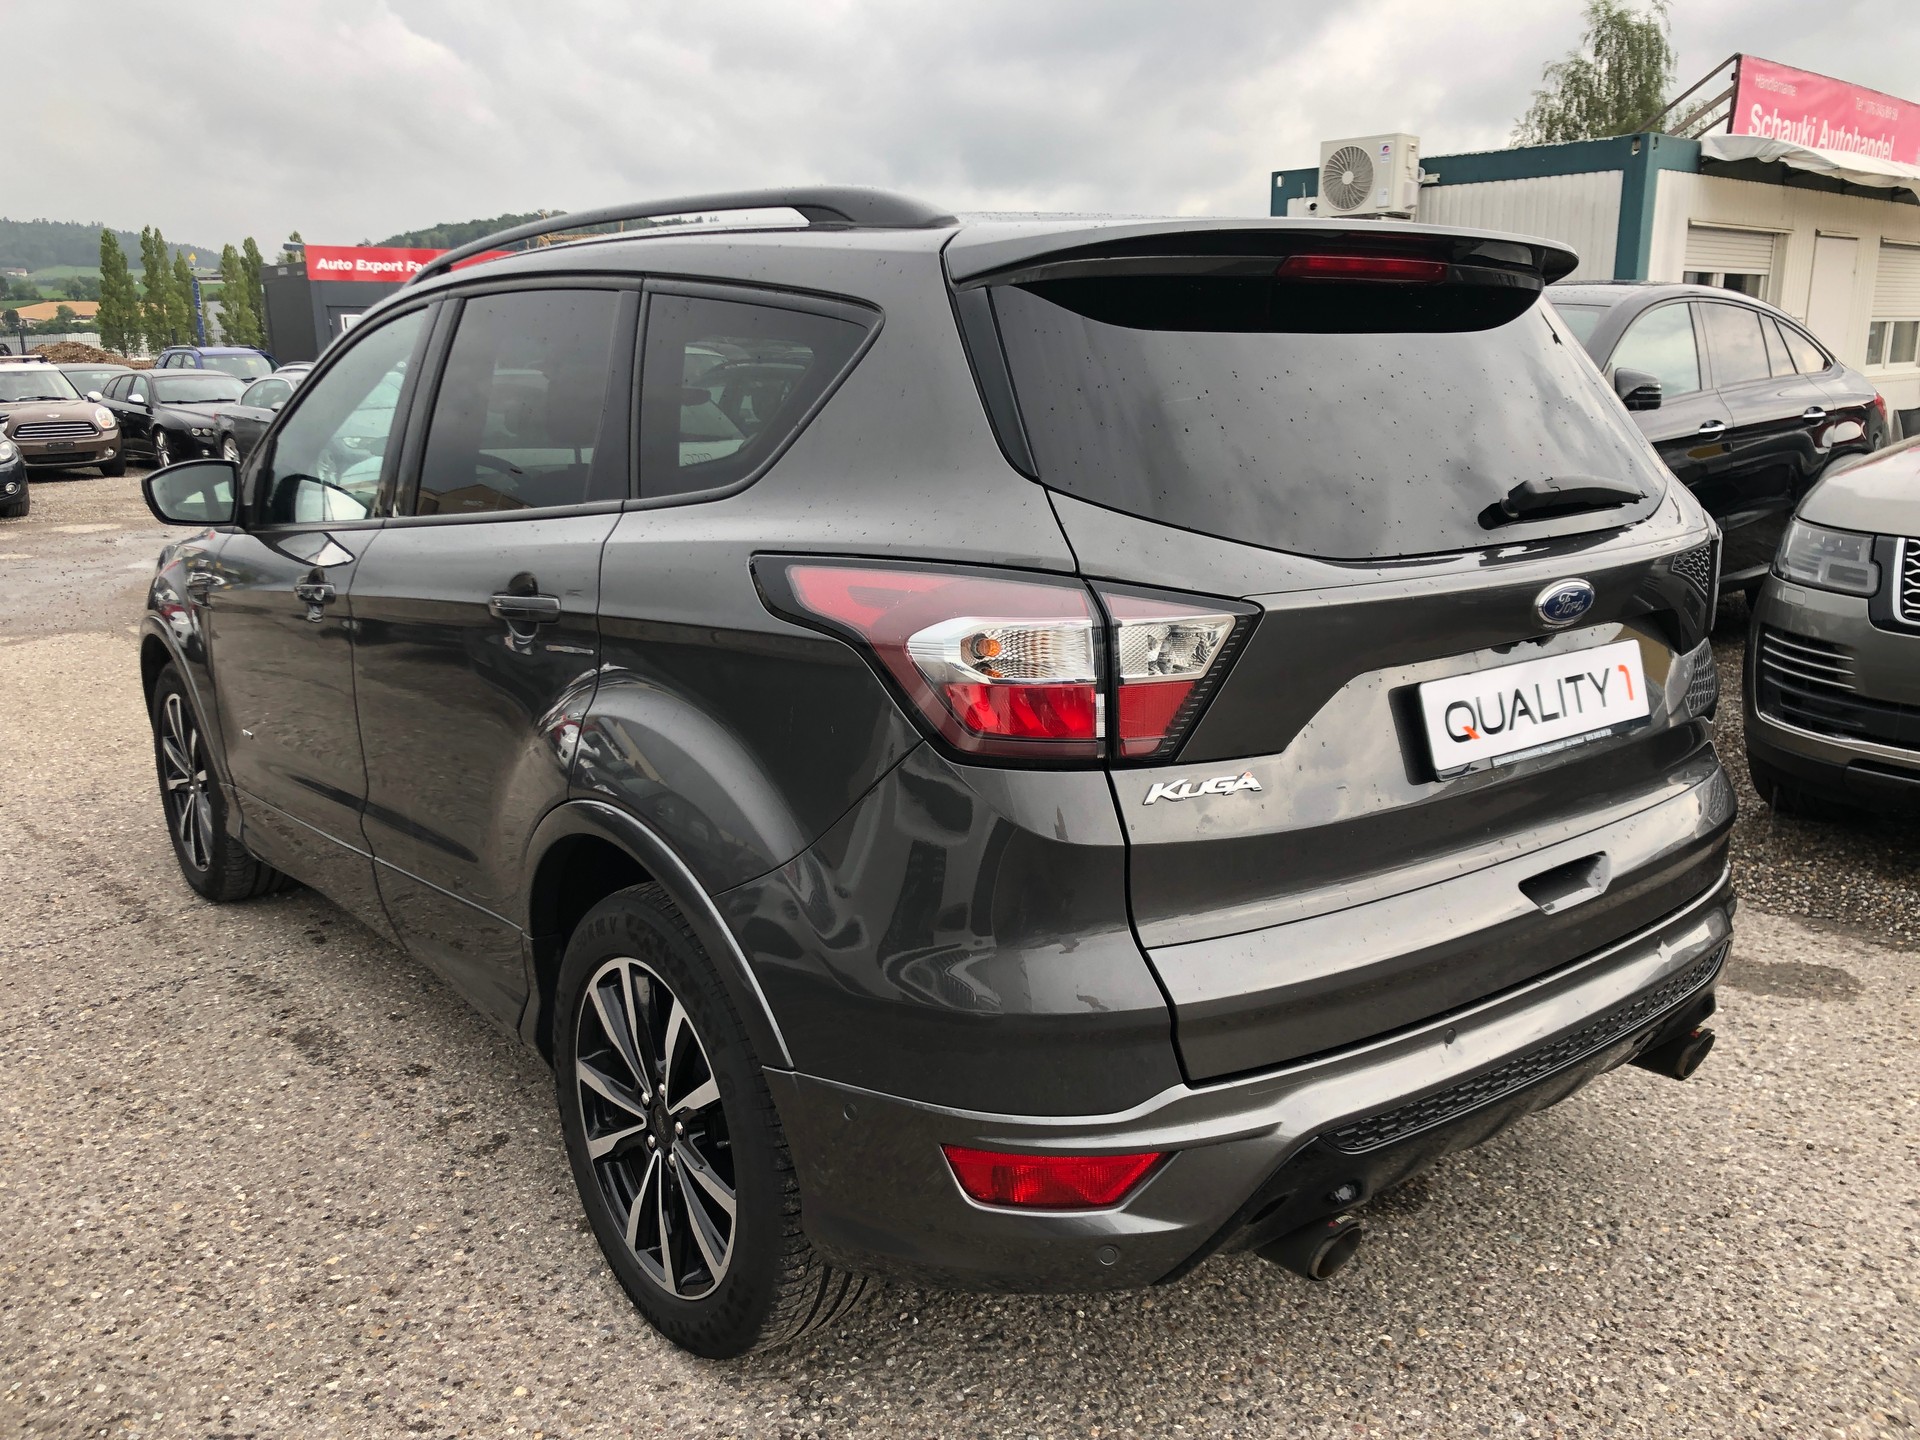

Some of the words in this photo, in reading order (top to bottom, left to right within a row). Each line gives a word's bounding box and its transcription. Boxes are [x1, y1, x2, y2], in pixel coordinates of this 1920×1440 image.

[1749, 104, 1816, 148] Schauki
[1816, 120, 1895, 161] Autohandel
[316, 257, 353, 271] Auto
[355, 259, 404, 274] Export
[1554, 591, 1586, 616] Ford
[1142, 771, 1263, 806] KUGA
